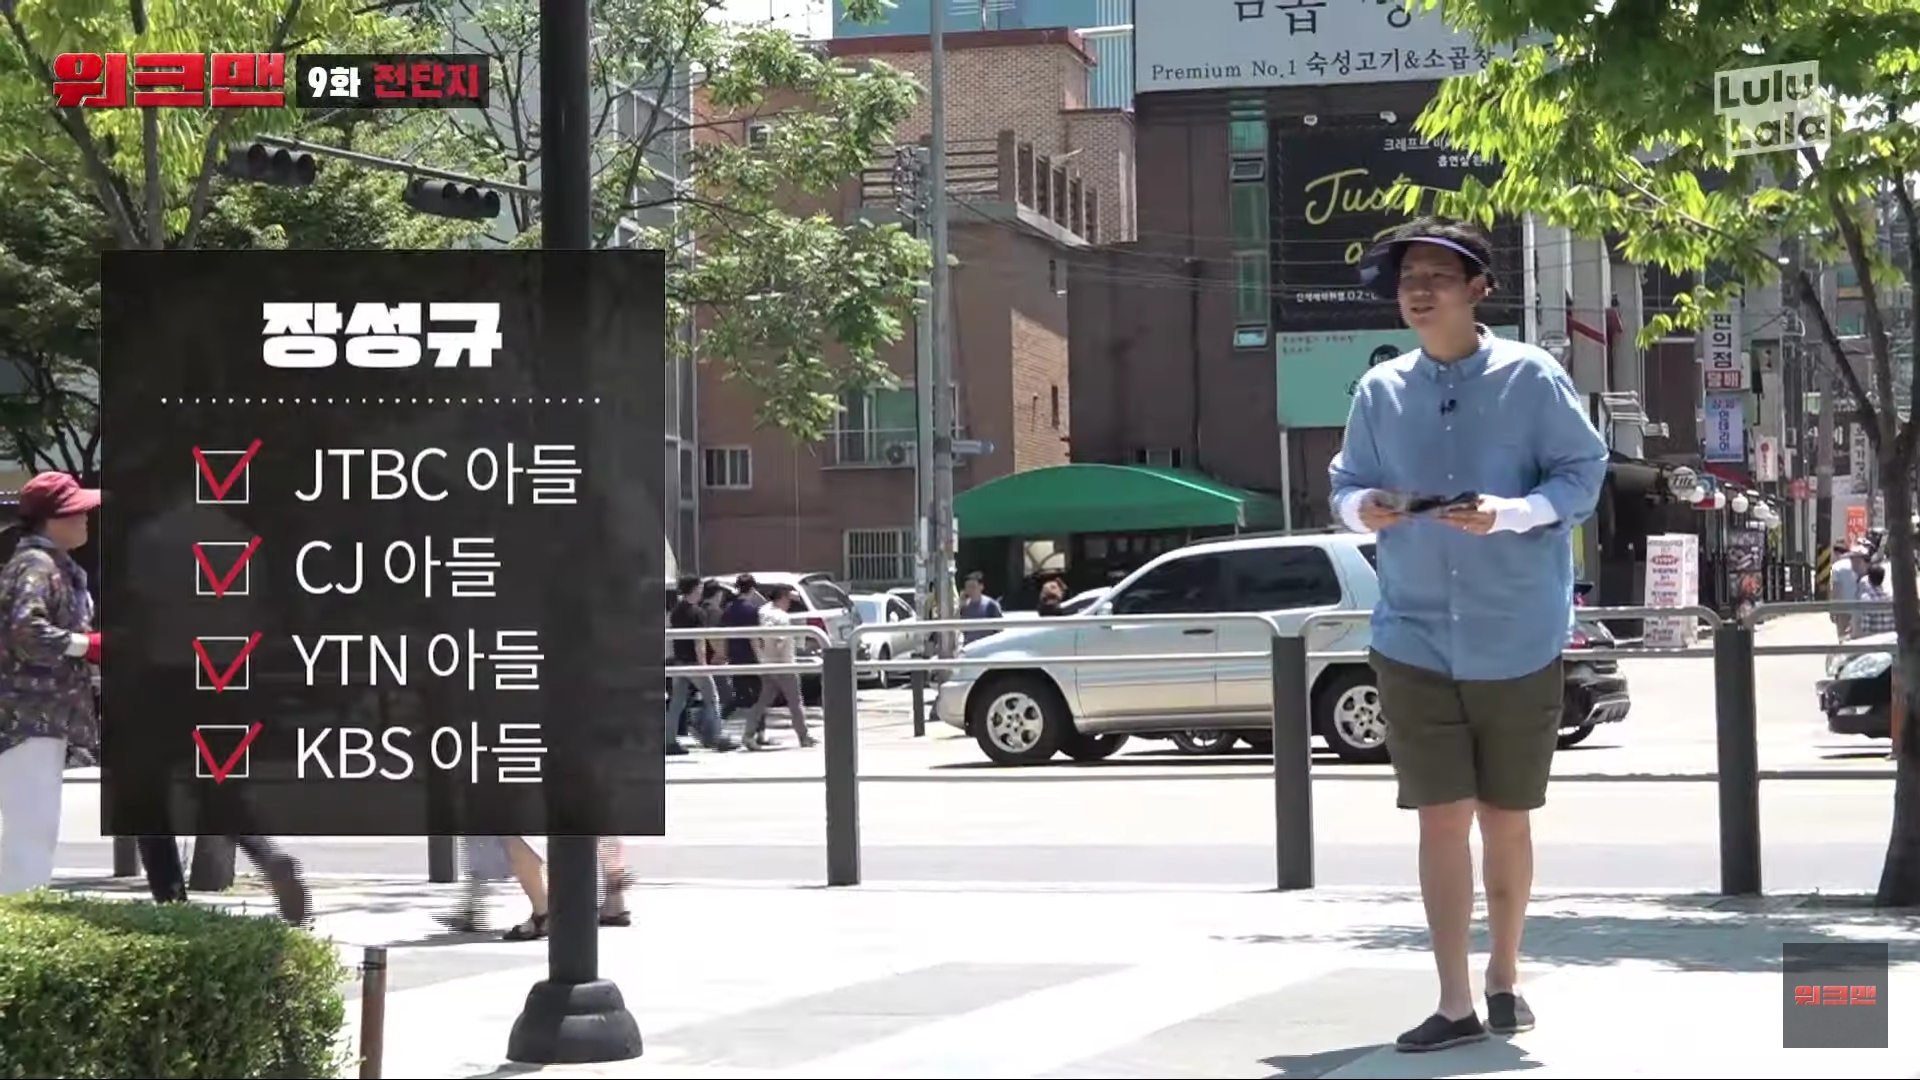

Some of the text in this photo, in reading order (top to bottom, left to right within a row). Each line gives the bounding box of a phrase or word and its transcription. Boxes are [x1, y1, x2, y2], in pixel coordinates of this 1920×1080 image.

[1152, 61, 1242, 81] Premium
[1252, 59, 1298, 78] No.1
[1711, 312, 1732, 369] 편의점
